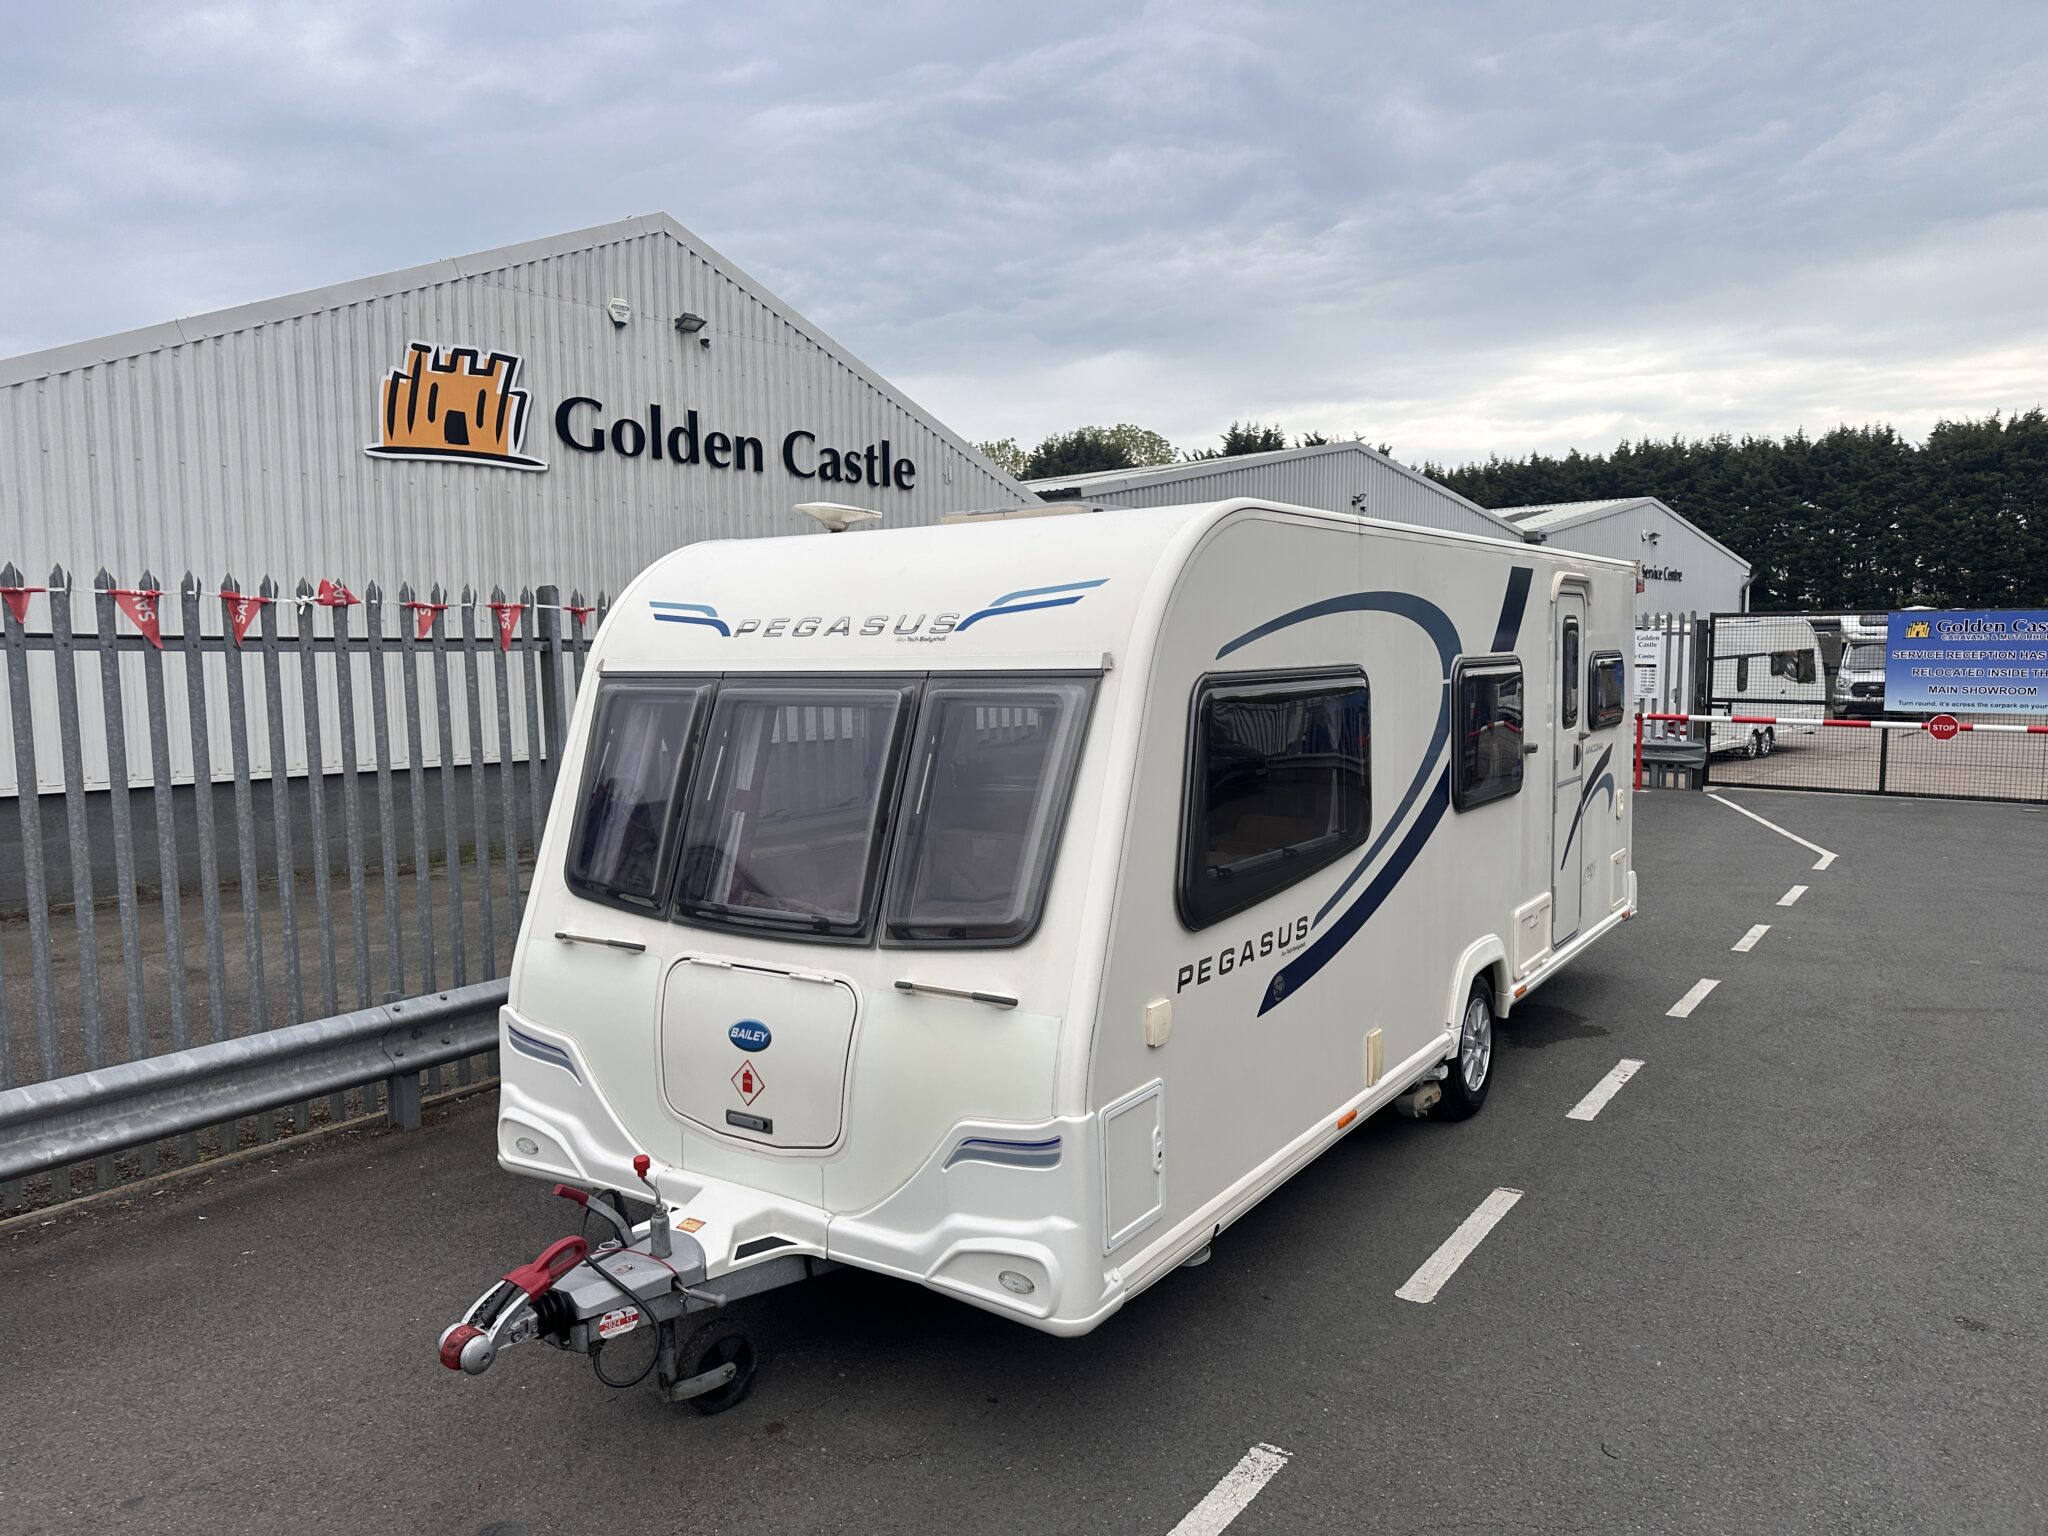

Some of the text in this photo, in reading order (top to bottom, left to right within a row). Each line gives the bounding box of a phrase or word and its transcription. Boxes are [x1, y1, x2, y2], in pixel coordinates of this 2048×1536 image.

[554, 396, 916, 490] Golden Castle
[733, 612, 960, 638] PEGASUS
[1936, 618, 2048, 633] Golden Cas
[1892, 650, 2046, 660] SERVICE RECEPTION HAS
[1912, 667, 1984, 678] RELOCATED
[1987, 668, 2029, 678] INSIDE
[1928, 685, 2038, 696] MAIN SHOWROOM
[1177, 916, 1308, 994] PEGASUS
[730, 1027, 768, 1042] BAILEY
[604, 1319, 621, 1330] 2024
